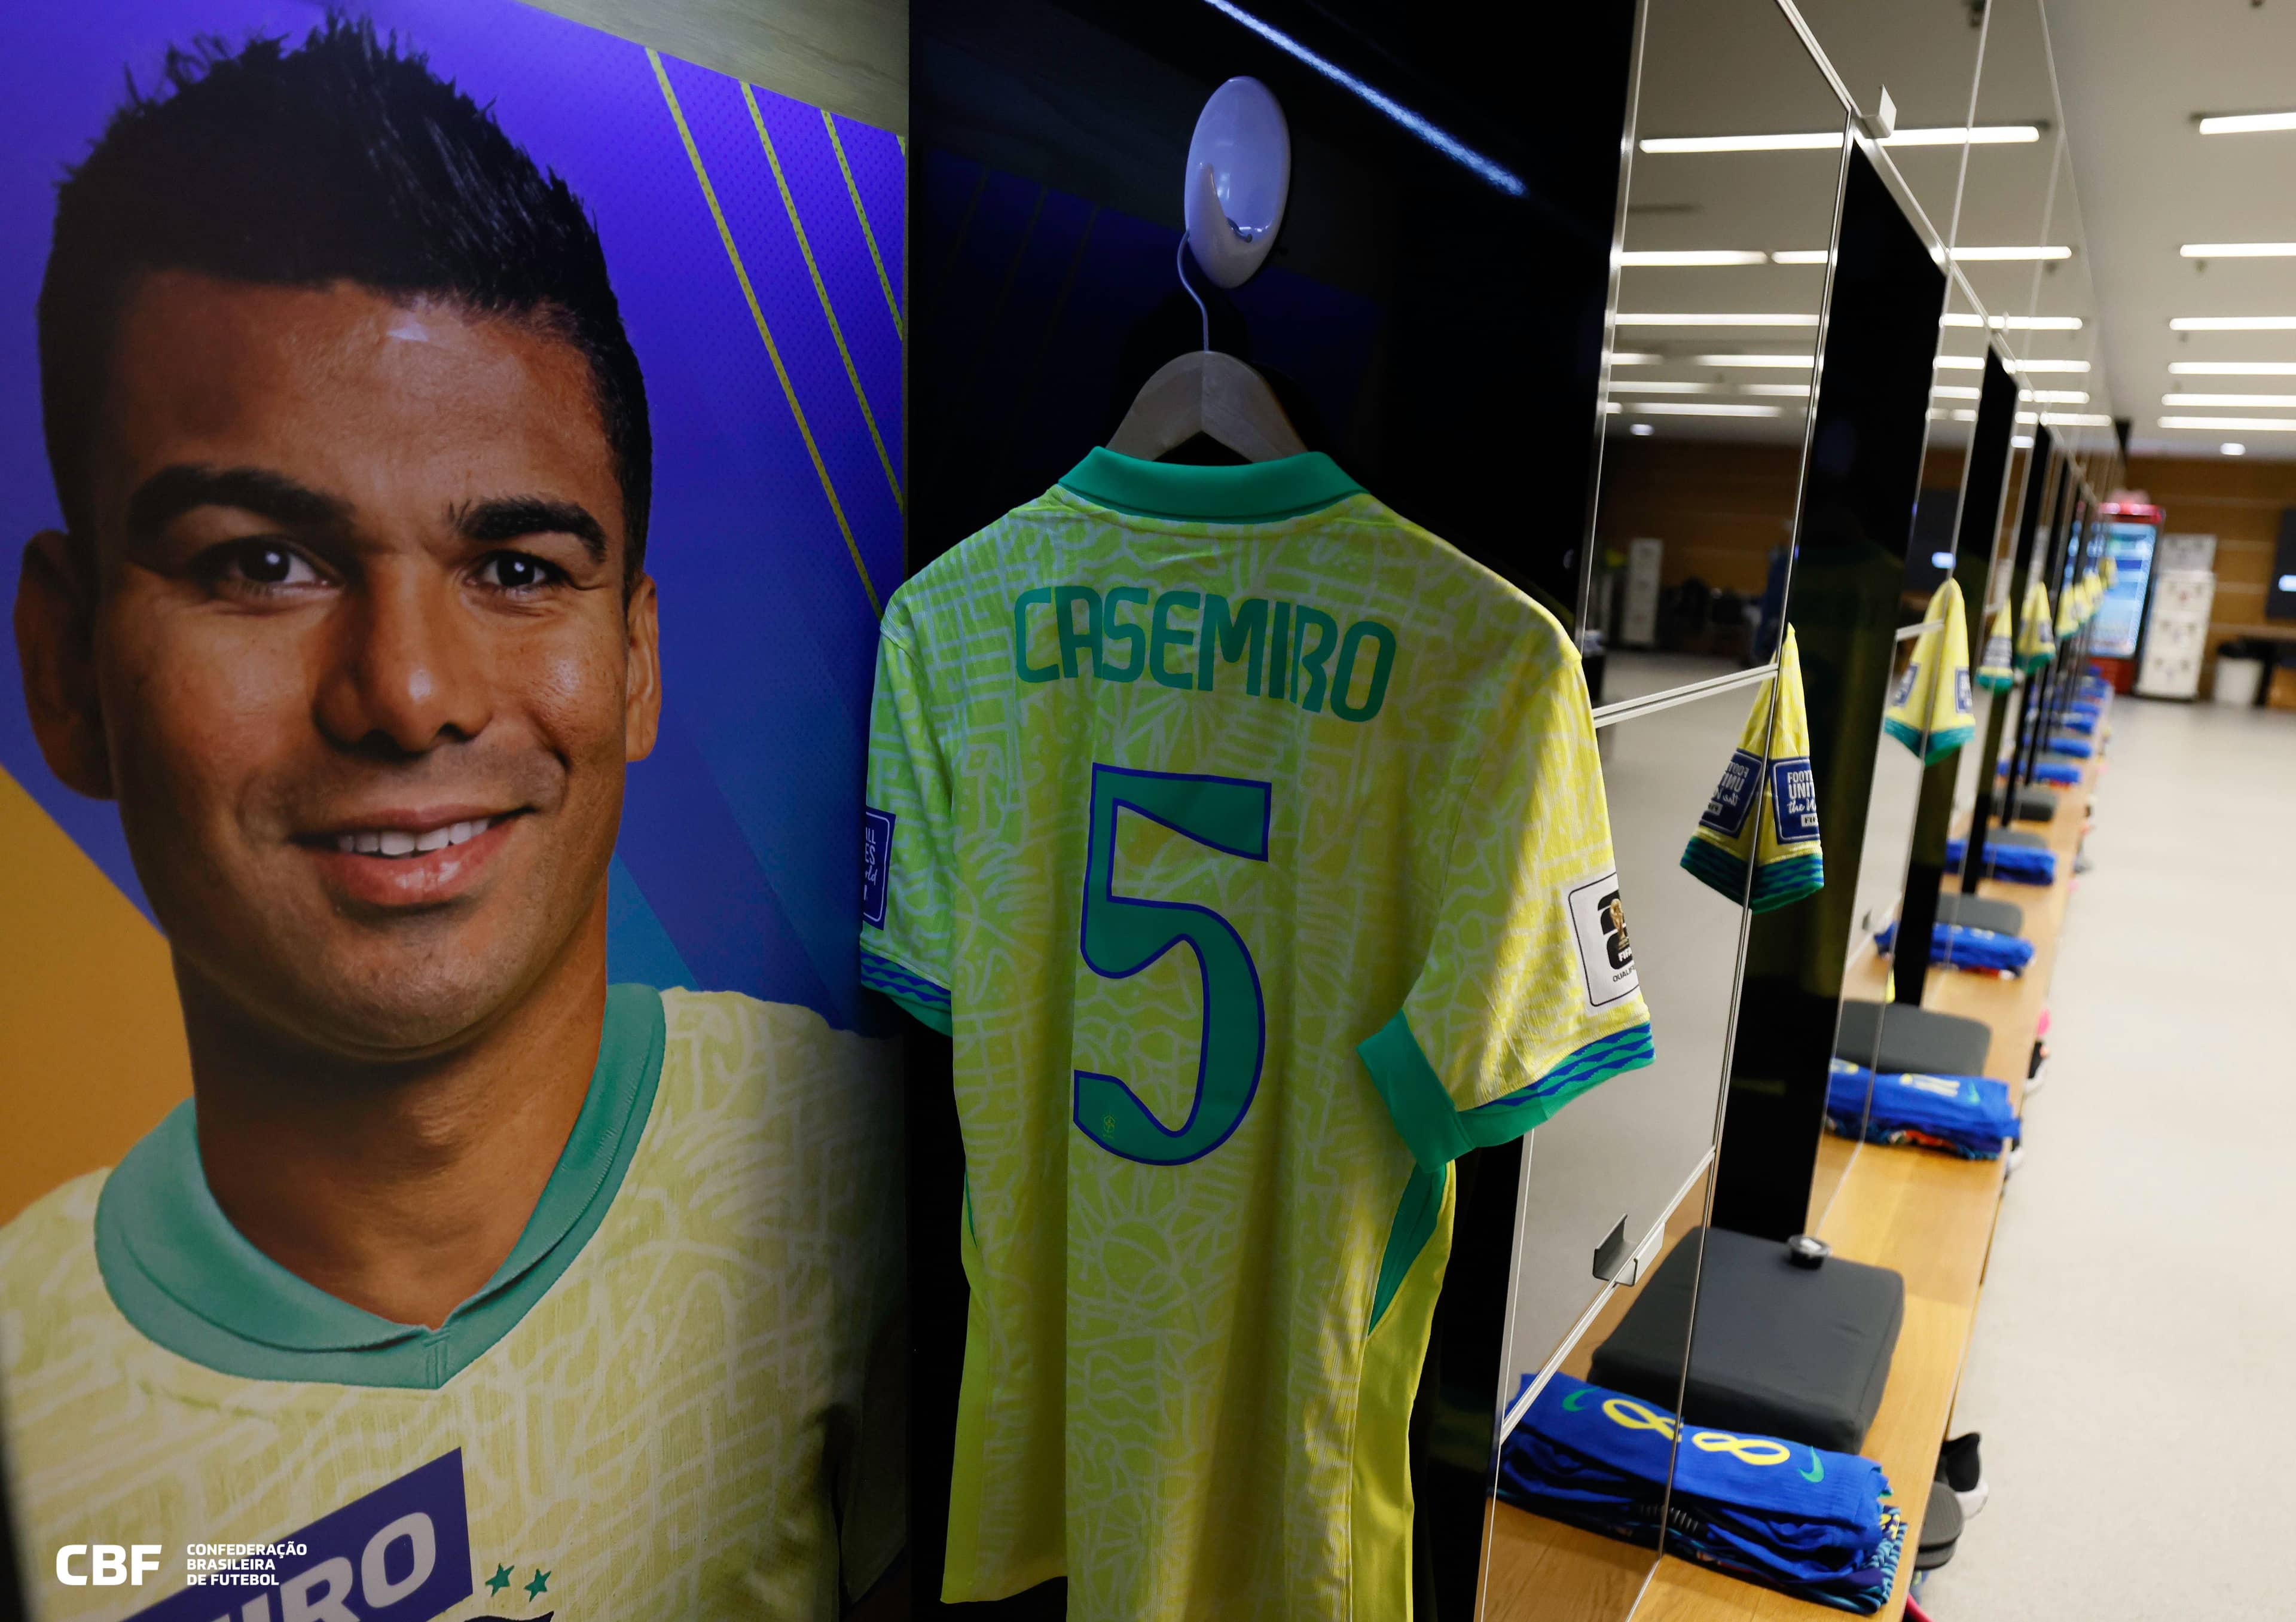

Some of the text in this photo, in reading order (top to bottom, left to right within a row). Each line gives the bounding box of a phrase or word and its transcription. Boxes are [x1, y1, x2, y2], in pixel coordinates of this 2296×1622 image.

[1014, 585, 1396, 722] CASEMIRO
[1073, 762, 1272, 1166] 5
[1692, 1432, 1790, 1465] 8
